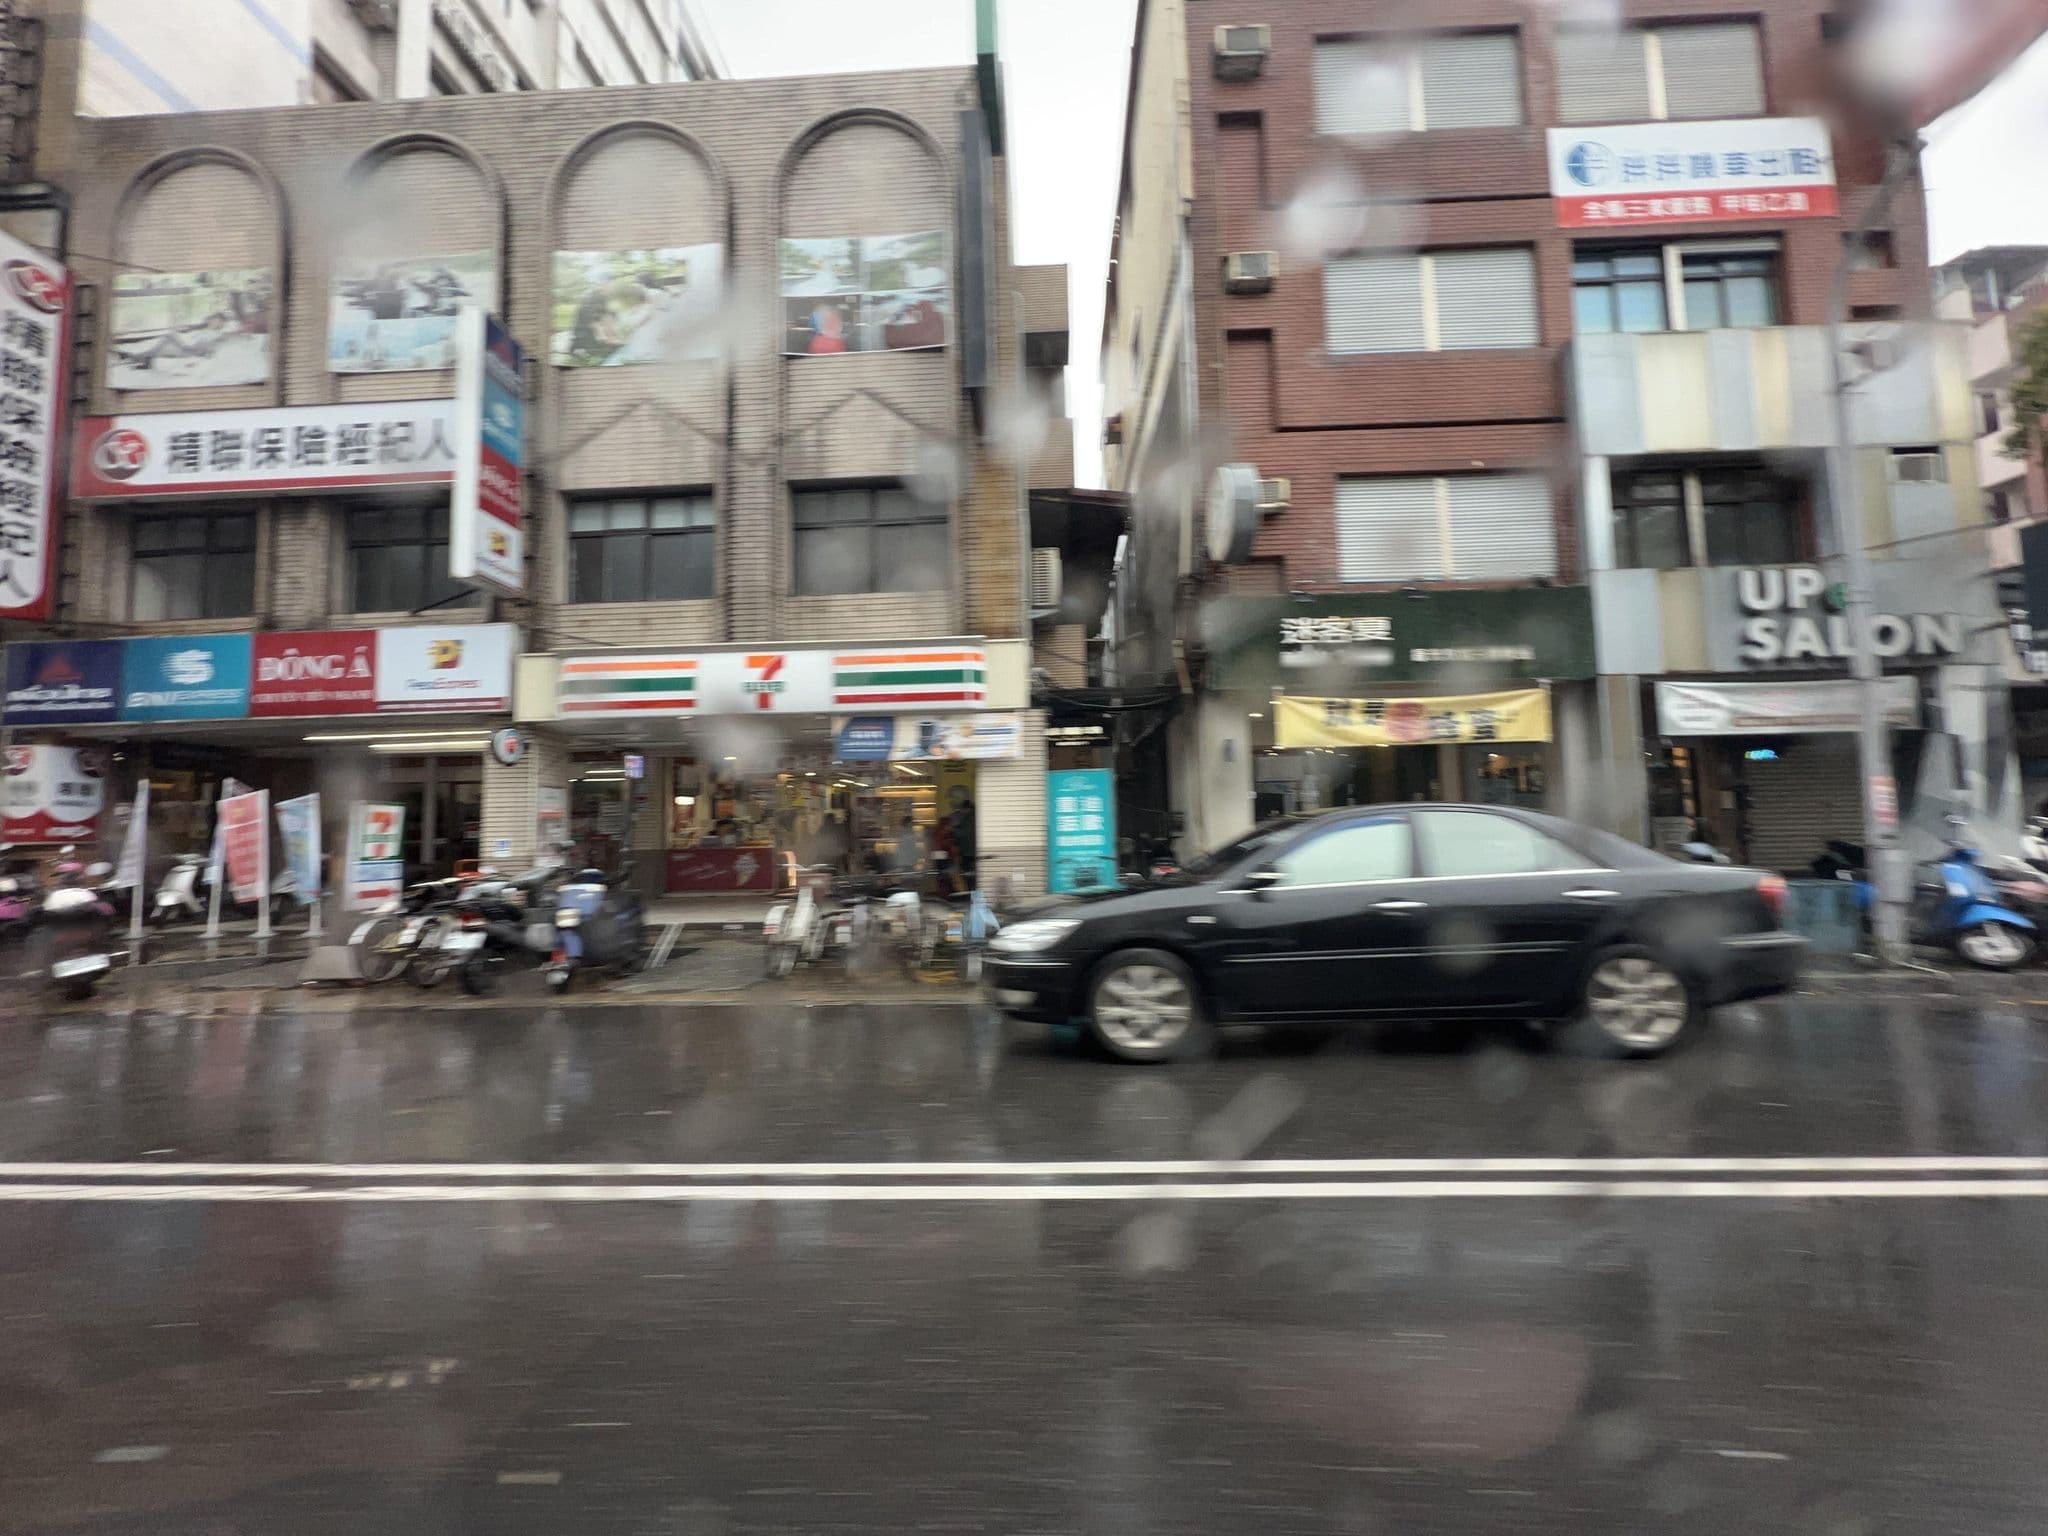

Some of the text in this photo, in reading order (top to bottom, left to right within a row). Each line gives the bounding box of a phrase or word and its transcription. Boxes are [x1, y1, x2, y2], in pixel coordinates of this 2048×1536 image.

[1740, 568, 1827, 610] UP
[1280, 616, 1394, 643] 迷客夏
[1743, 614, 1961, 660] SALON
